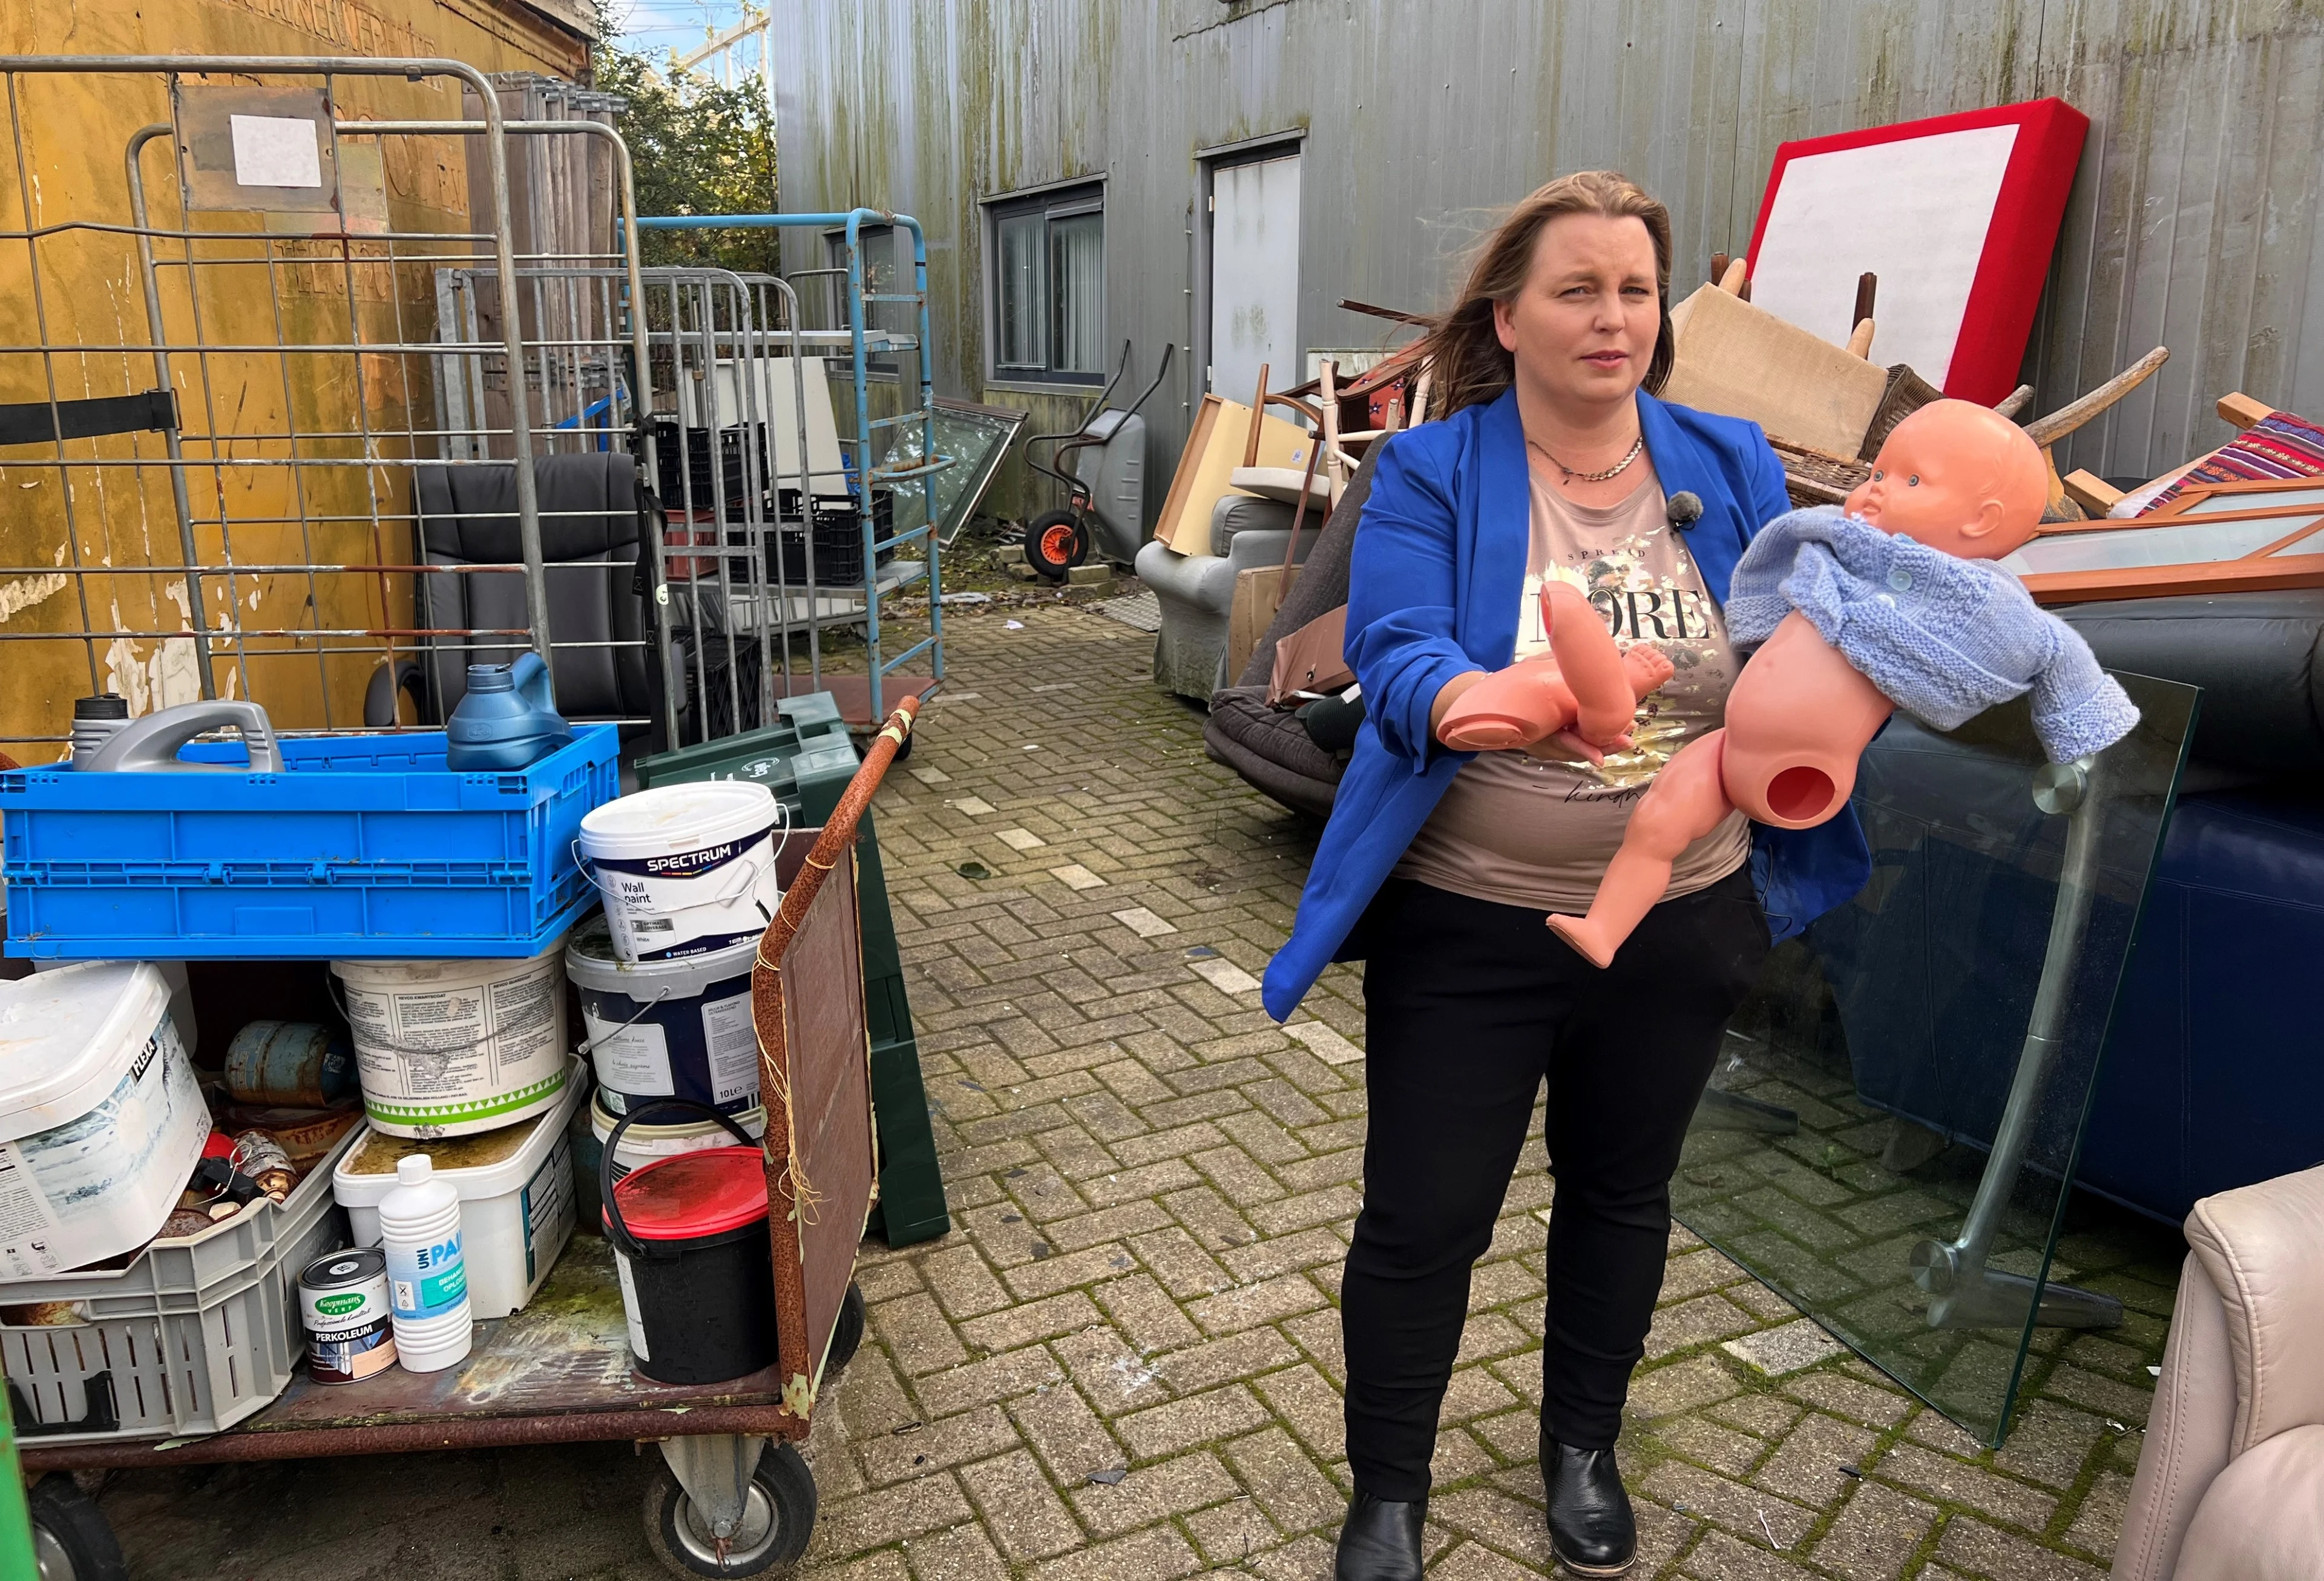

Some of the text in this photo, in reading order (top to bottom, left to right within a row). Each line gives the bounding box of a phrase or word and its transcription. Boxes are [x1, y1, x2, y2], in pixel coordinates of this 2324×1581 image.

[1567, 548, 1645, 560] SPREAD
[1530, 588, 1710, 642] ORE
[647, 845, 731, 872] SPECTRUM
[621, 882, 645, 893] Wall
[625, 893, 652, 906] paint
[133, 1039, 156, 1077] FLEXA
[320, 1295, 361, 1309] Koopmans
[315, 1324, 373, 1343] PERKOLEUM
